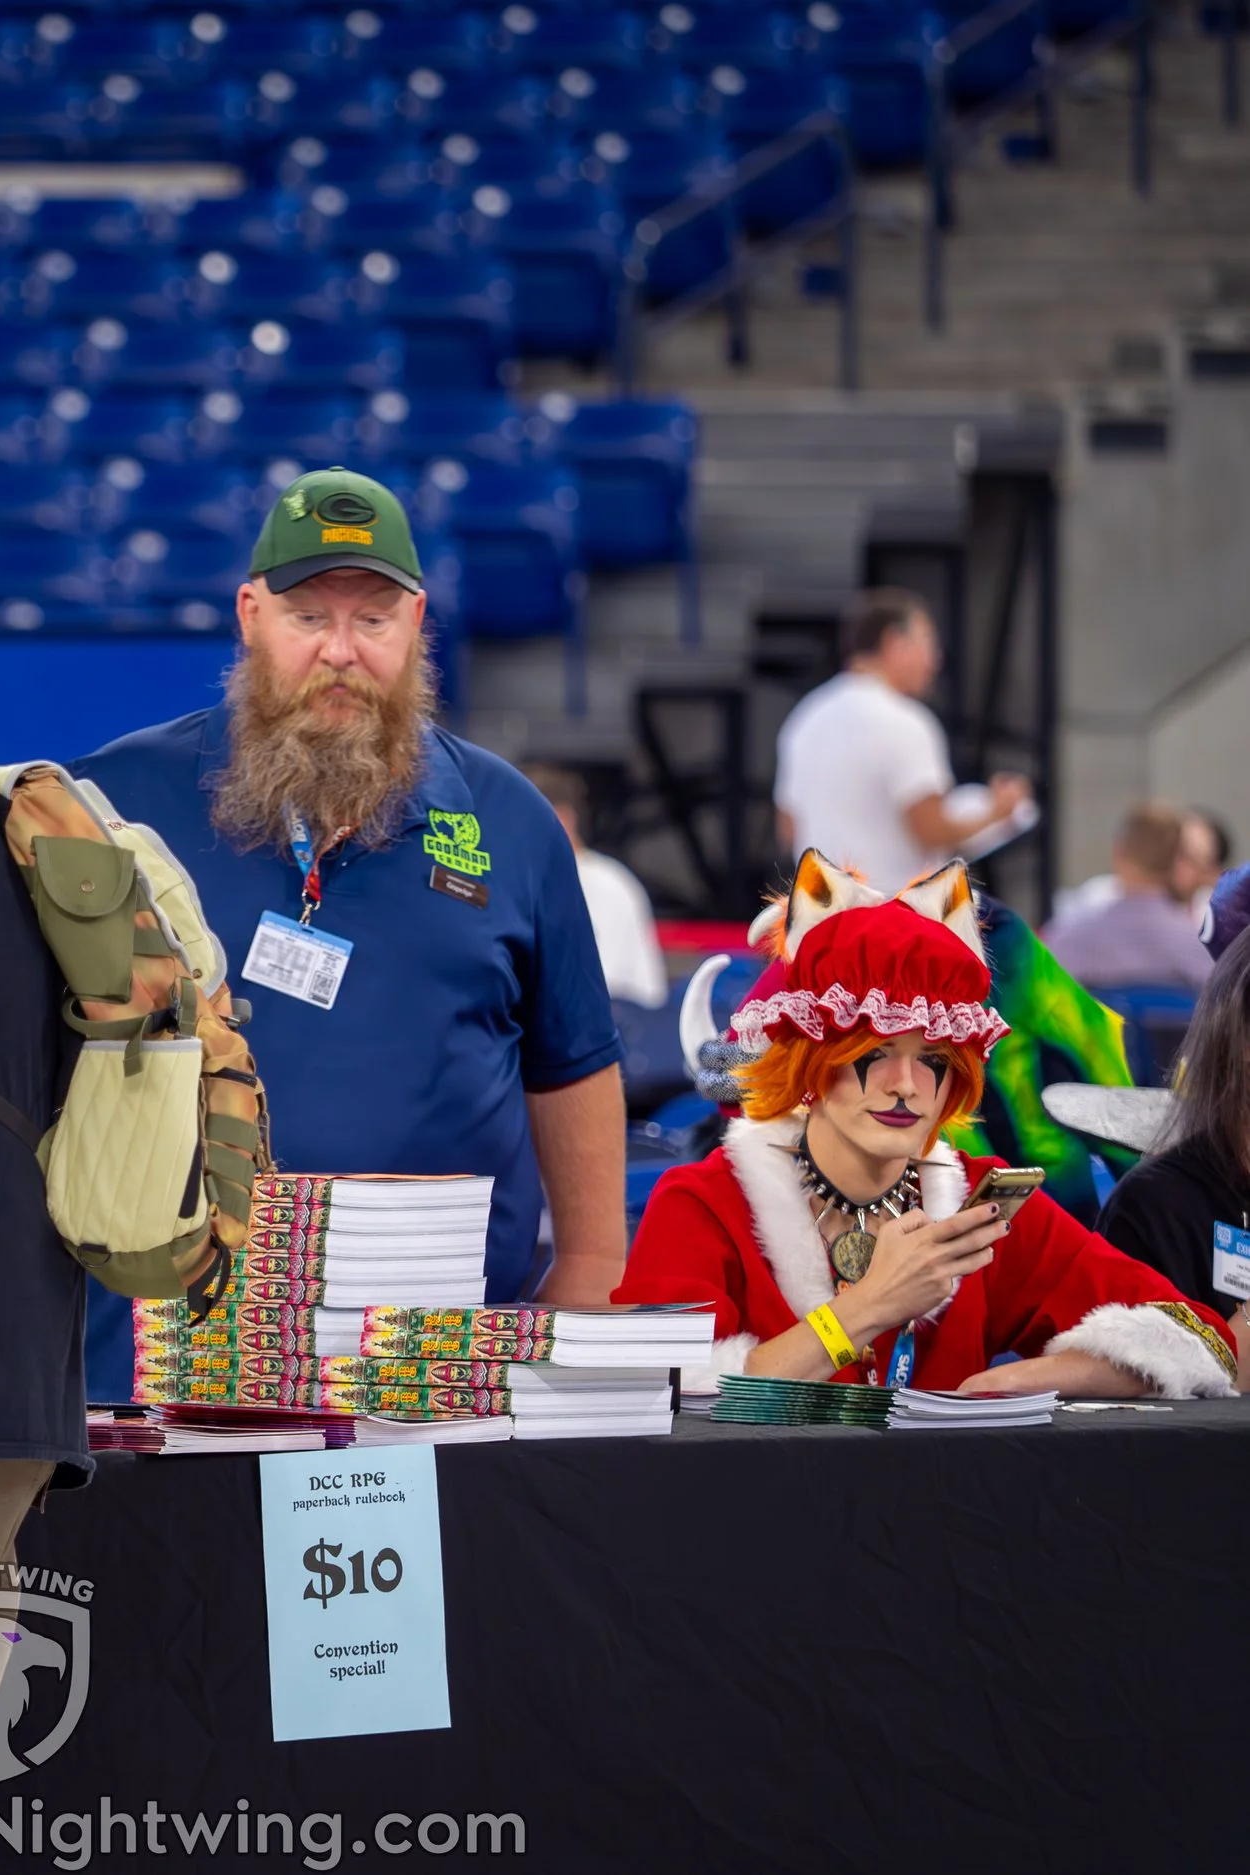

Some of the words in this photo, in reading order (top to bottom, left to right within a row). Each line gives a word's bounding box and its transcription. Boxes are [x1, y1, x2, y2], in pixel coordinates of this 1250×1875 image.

[309, 1475, 343, 1491] DCC
[350, 1472, 386, 1488] RPG
[293, 1494, 351, 1512] paperback
[355, 1490, 406, 1505] rulebook
[303, 1538, 403, 1610] $10
[314, 1640, 398, 1660] Convention
[329, 1660, 386, 1681] special!
